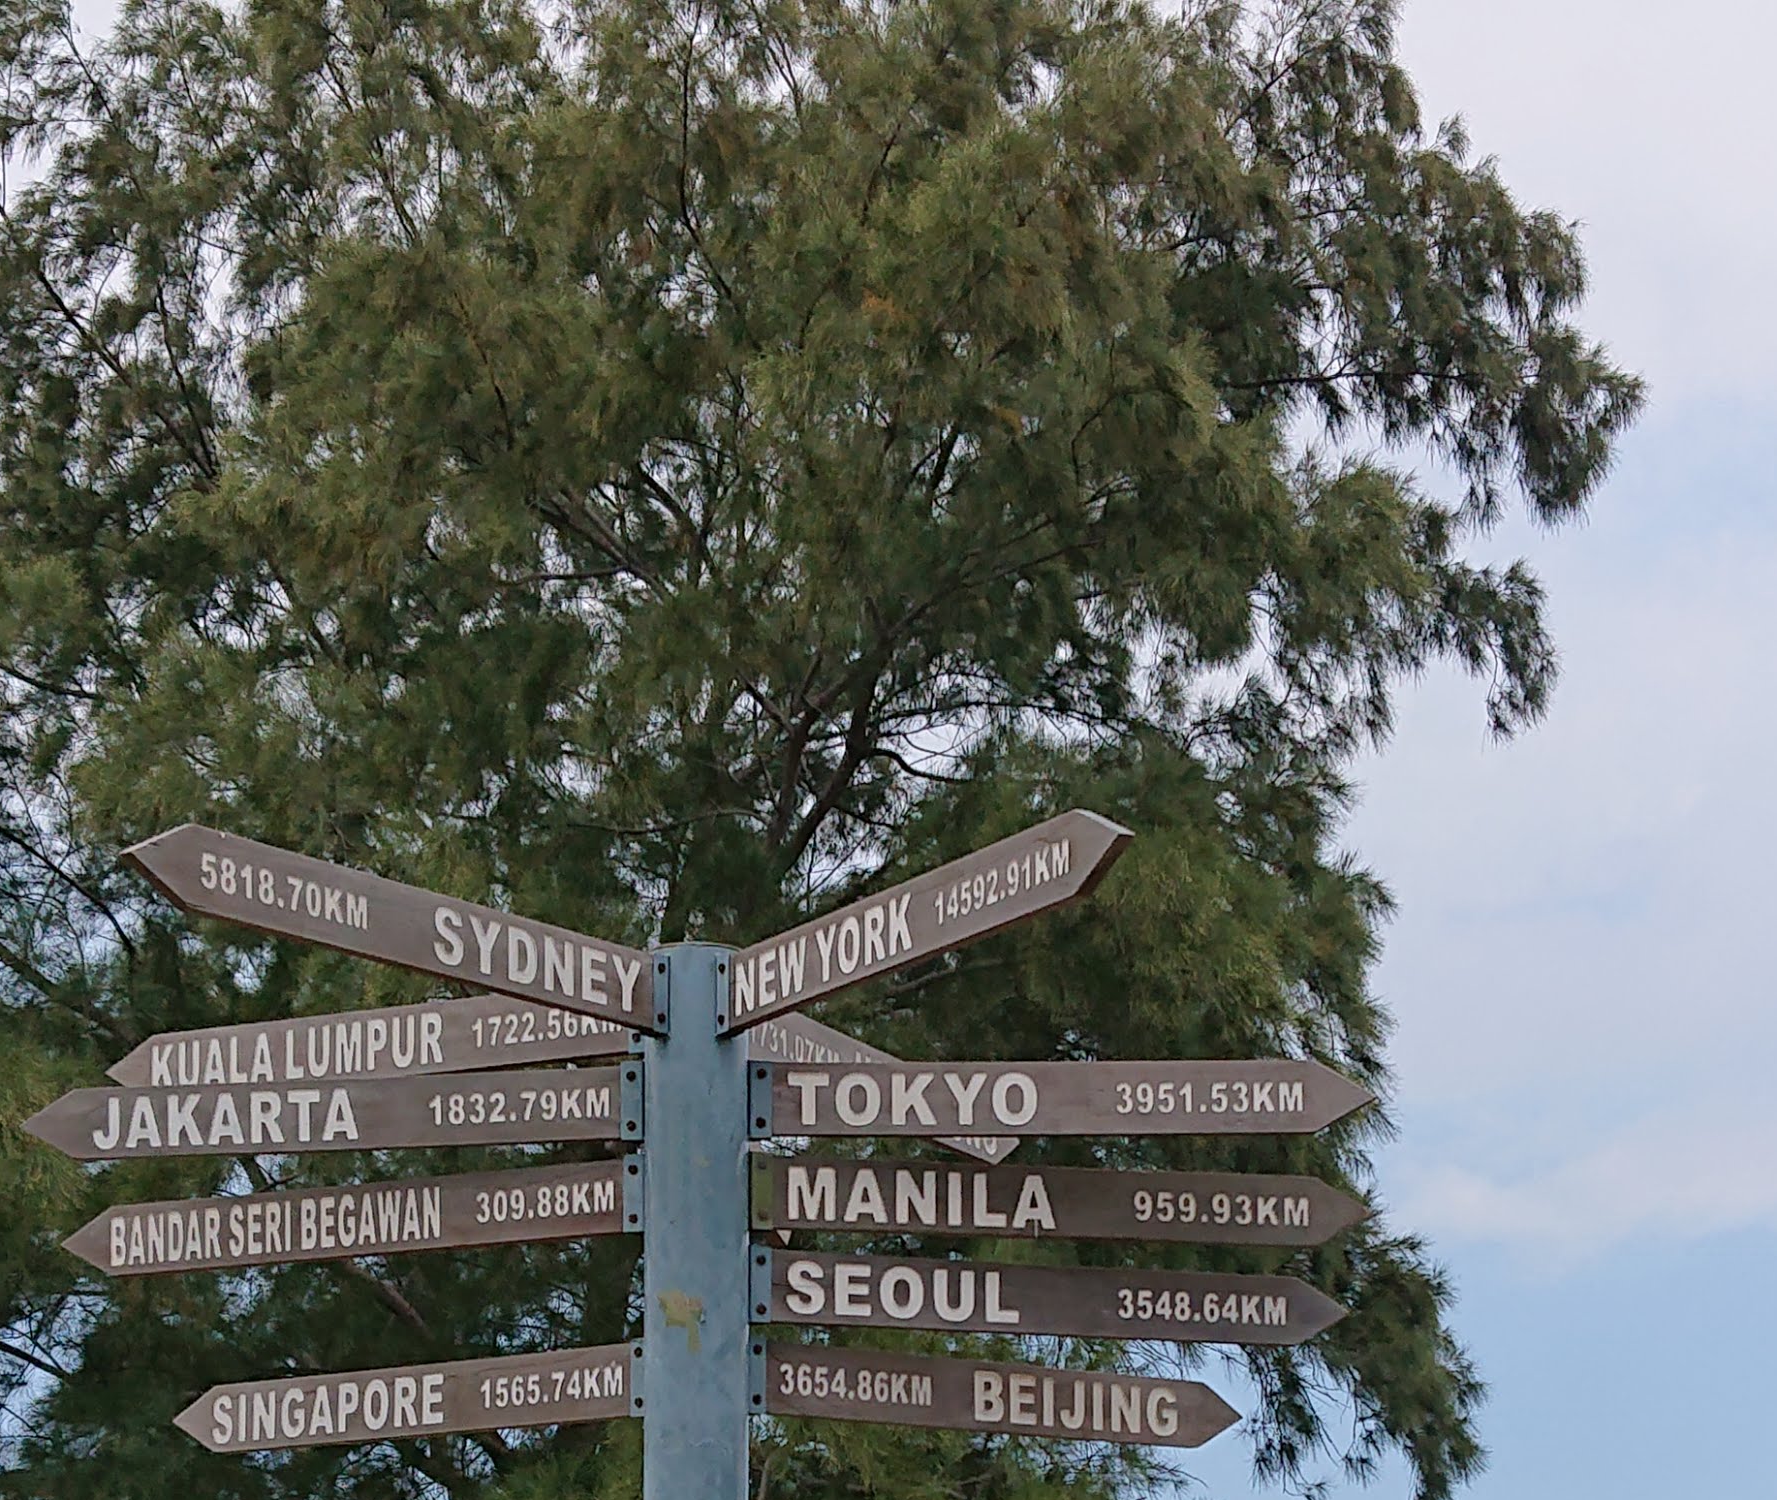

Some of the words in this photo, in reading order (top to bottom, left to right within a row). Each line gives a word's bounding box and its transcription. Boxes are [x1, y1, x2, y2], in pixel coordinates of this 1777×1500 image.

[201, 852, 369, 930] 5818.70KM
[433, 905, 641, 1013] SYDNEY
[734, 935, 807, 1018] NEW
[815, 892, 912, 982] YORK
[934, 838, 1070, 926] 14592.91KM
[150, 1032, 274, 1087] KUALA
[285, 1012, 443, 1079] LUMPUR
[92, 1088, 359, 1150] JAKARTA
[428, 1087, 611, 1126] 1832.79KM
[787, 1071, 1039, 1126] TOKYO
[1116, 1082, 1305, 1114] 3951.53KM
[109, 1207, 222, 1267] BANDAR
[228, 1200, 292, 1256] SERI
[301, 1186, 441, 1250] BEGAWAN
[475, 1180, 615, 1224] 309.88KM
[786, 1166, 1056, 1230] MANILA
[1133, 1189, 1310, 1228] 959.93KM
[786, 1261, 1020, 1323] SEOUL
[1117, 1288, 1287, 1326] 3548.64KM
[210, 1373, 445, 1444] SINGAPORE
[479, 1365, 624, 1408] 1565.74KM
[778, 1363, 932, 1406] 3654.86KM
[973, 1370, 1179, 1436] BEIJING
